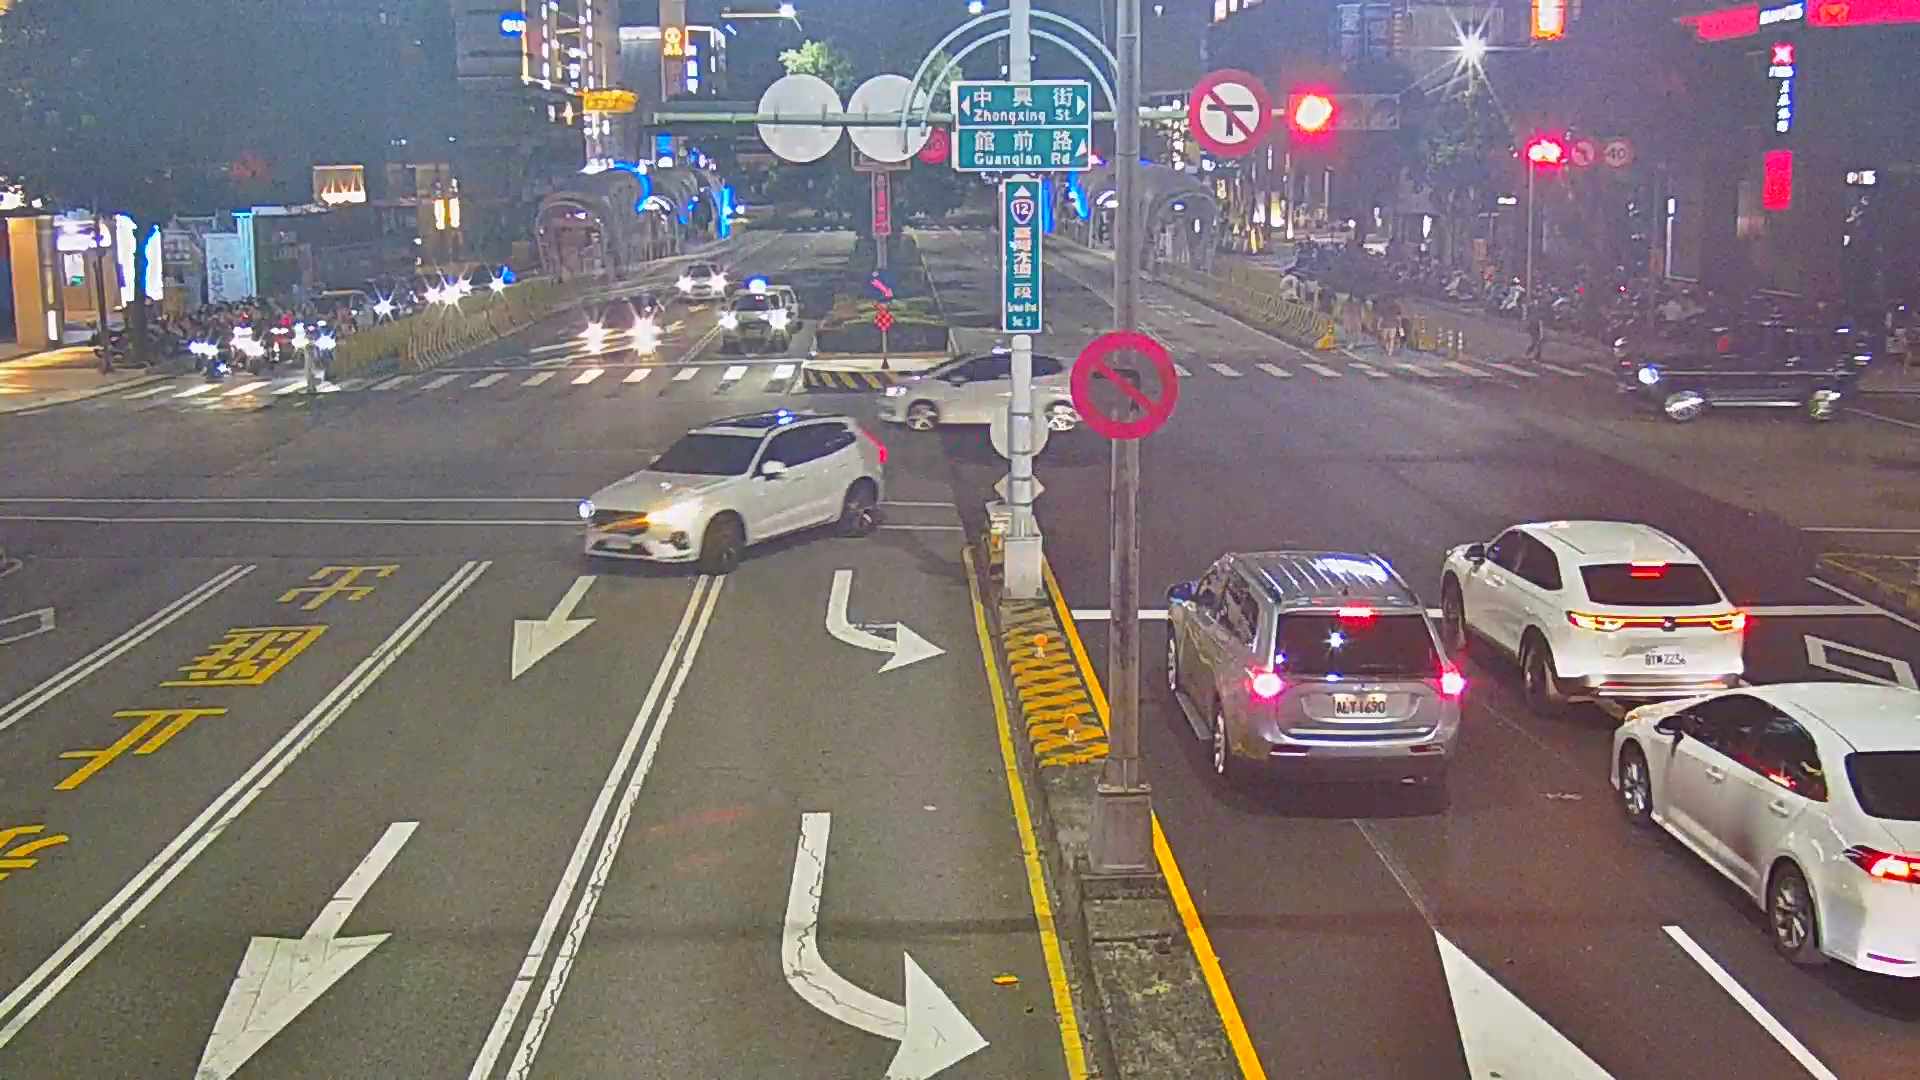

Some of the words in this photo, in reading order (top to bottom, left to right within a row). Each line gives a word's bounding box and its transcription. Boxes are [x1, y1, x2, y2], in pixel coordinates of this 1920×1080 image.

[973, 87, 1073, 108] 中興街
[973, 109, 1046, 124] Zhongxing
[1055, 109, 1072, 121] St
[975, 130, 1073, 152] 館前路
[974, 152, 1042, 166] Guanqian
[1051, 152, 1070, 165] Rd
[1015, 203, 1029, 215] 12
